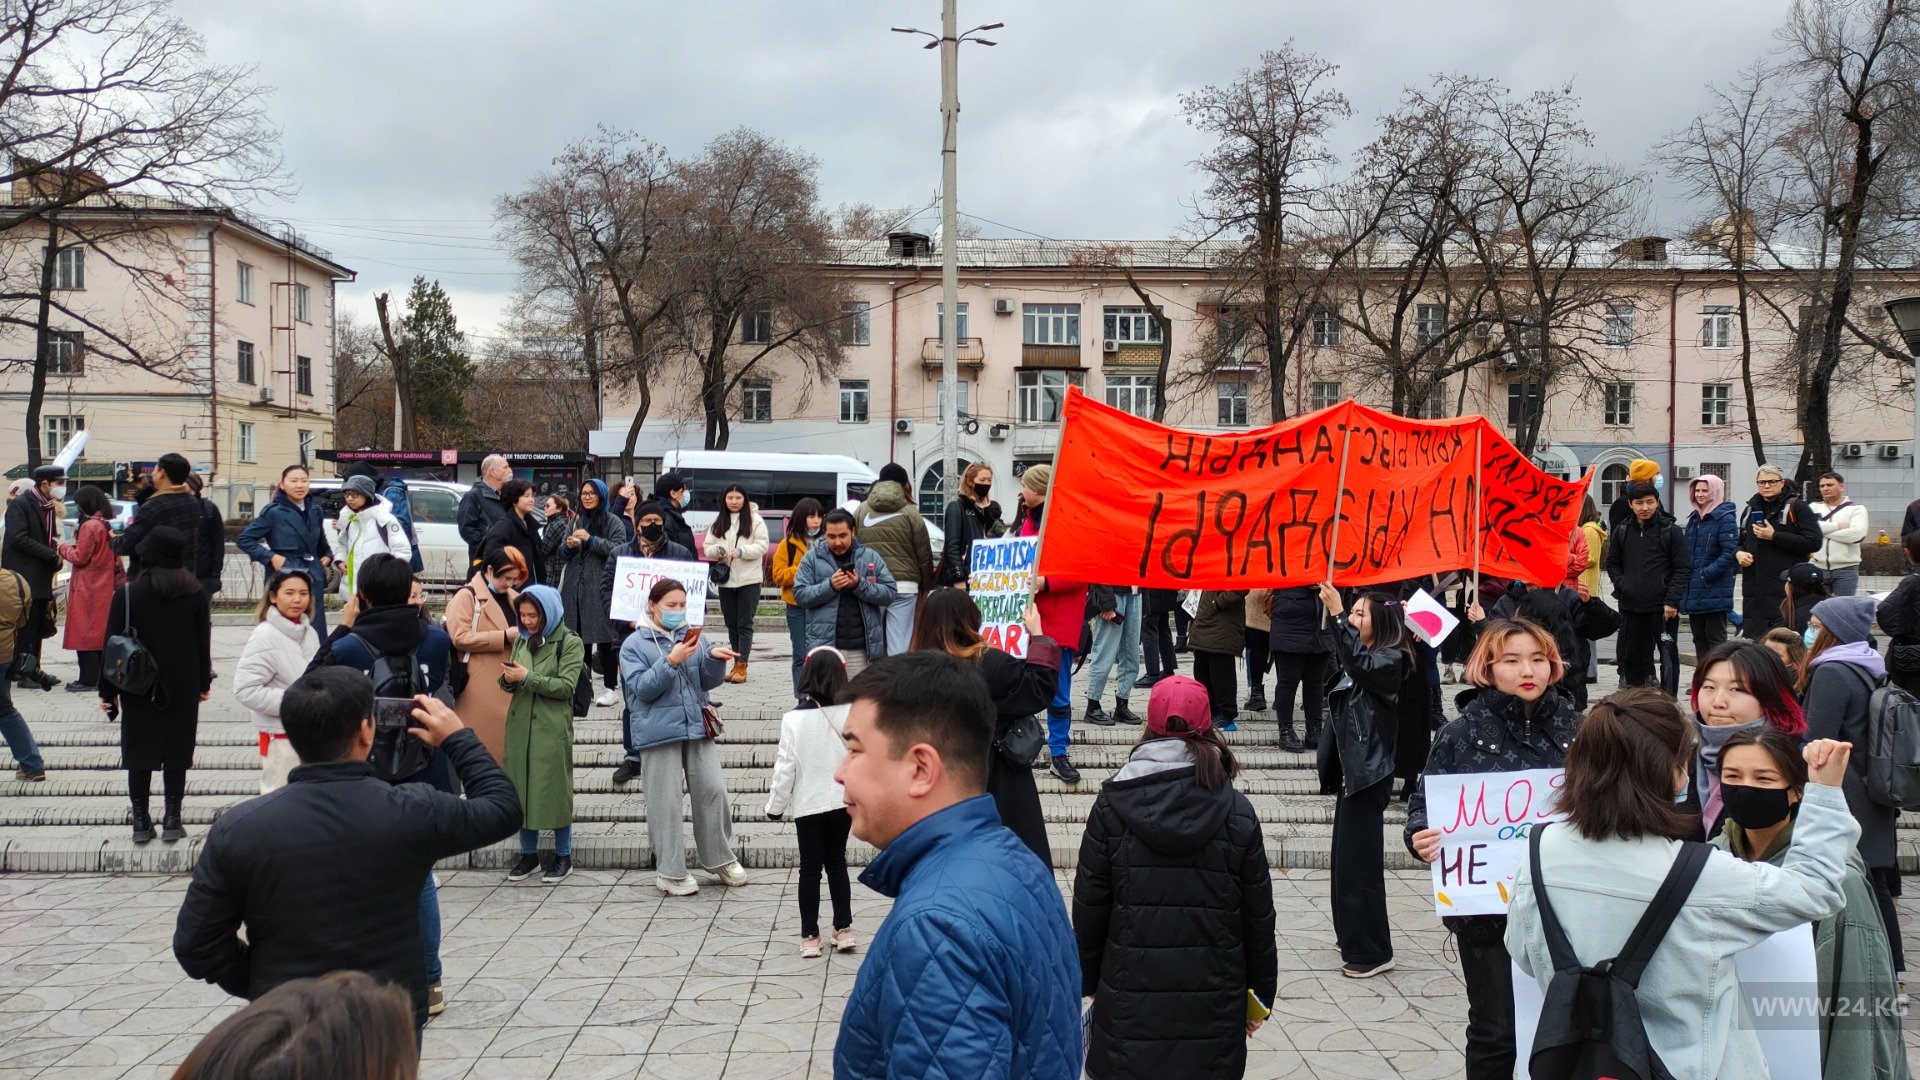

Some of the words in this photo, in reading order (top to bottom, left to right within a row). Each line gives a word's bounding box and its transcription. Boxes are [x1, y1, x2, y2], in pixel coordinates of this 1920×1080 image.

[973, 541, 1037, 572] FEMINISM
[686, 579, 705, 596] WAR
[970, 571, 1029, 592] AGAINST
[1440, 844, 1488, 887] НЕ
